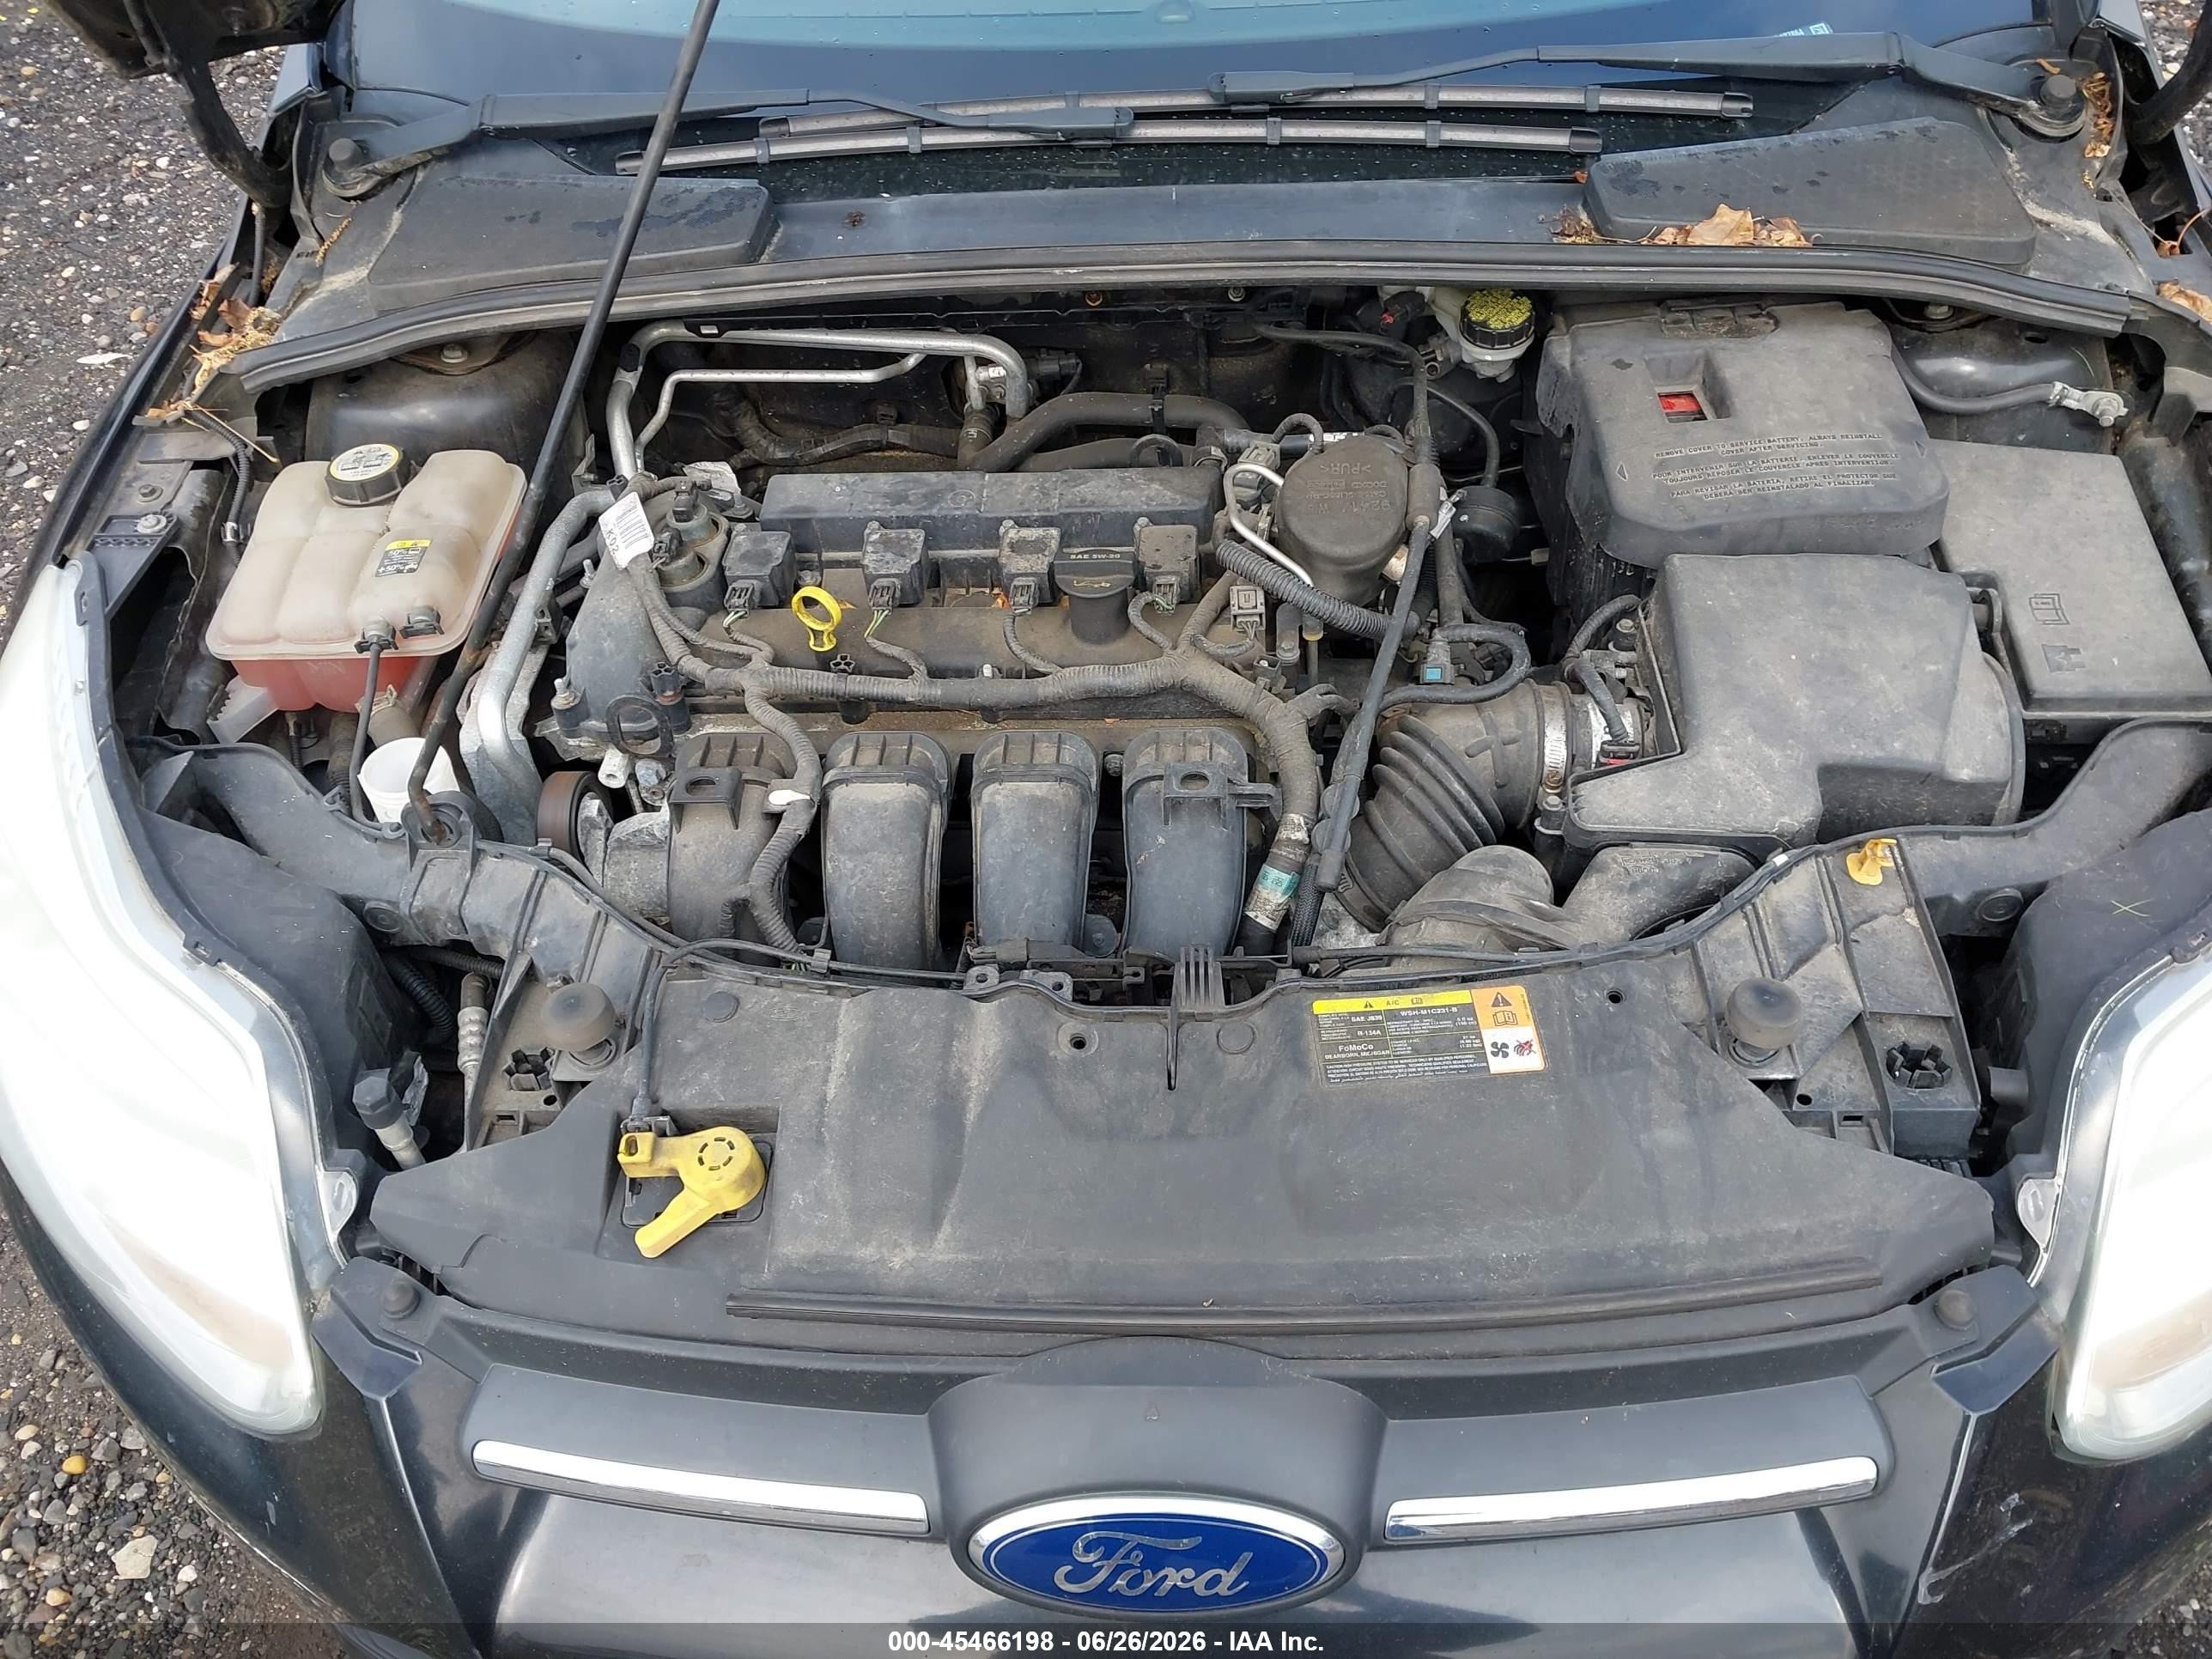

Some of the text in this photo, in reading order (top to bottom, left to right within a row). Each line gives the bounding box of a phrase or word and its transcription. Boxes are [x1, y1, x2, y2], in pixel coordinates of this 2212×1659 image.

[1655, 448, 1684, 458] REMOVE
[1730, 439, 1764, 447] SERVICE
[1676, 465, 1723, 475] INTERVENIR
[1664, 474, 1703, 483] TOUJOURS
[1707, 469, 1741, 478] REPOSER
[1695, 484, 1729, 494] REVISAR
[1758, 483, 1809, 492] REINSTALADO
[1339, 1043, 1374, 1052] FoMoCo
[1054, 1531, 1253, 1597] Ford
